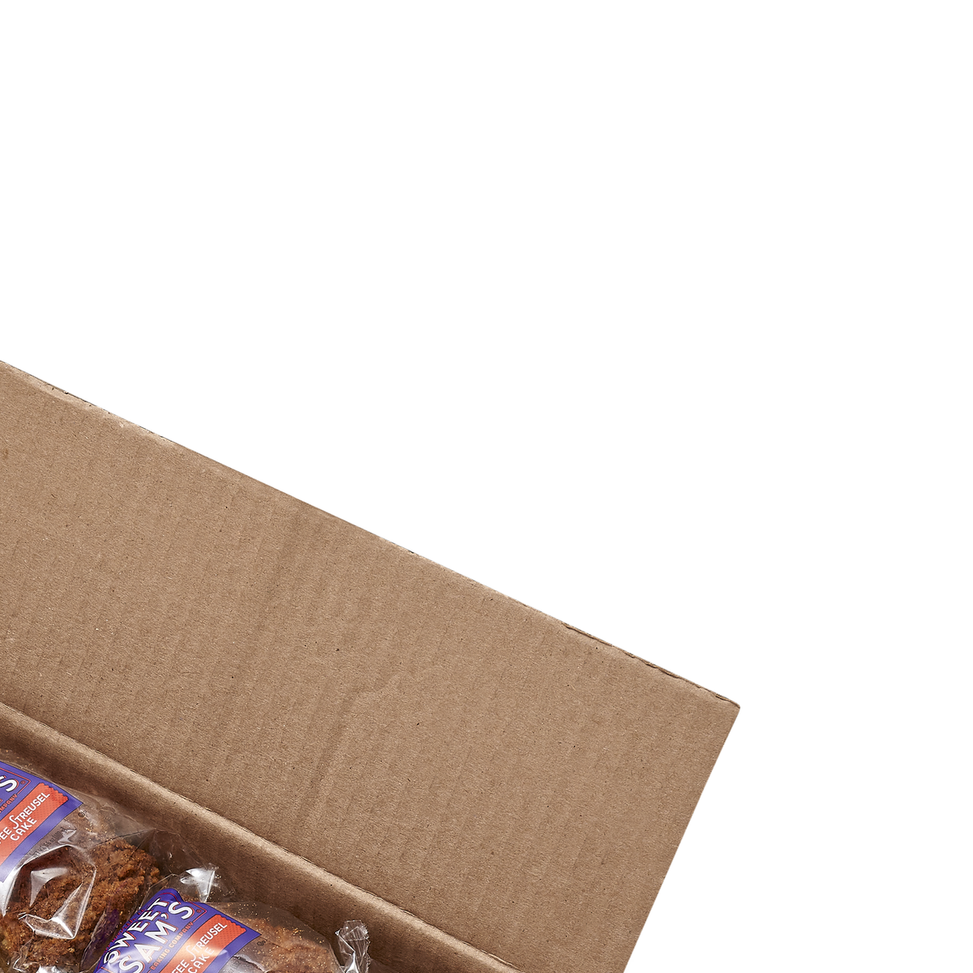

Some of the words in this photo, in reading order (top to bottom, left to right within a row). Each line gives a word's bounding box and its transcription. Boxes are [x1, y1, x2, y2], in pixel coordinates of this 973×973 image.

[9, 792, 50, 829] STREUSEL
[10, 817, 37, 841] CAKE
[103, 898, 169, 964] SWEET
[186, 922, 228, 962] STREUSEL
